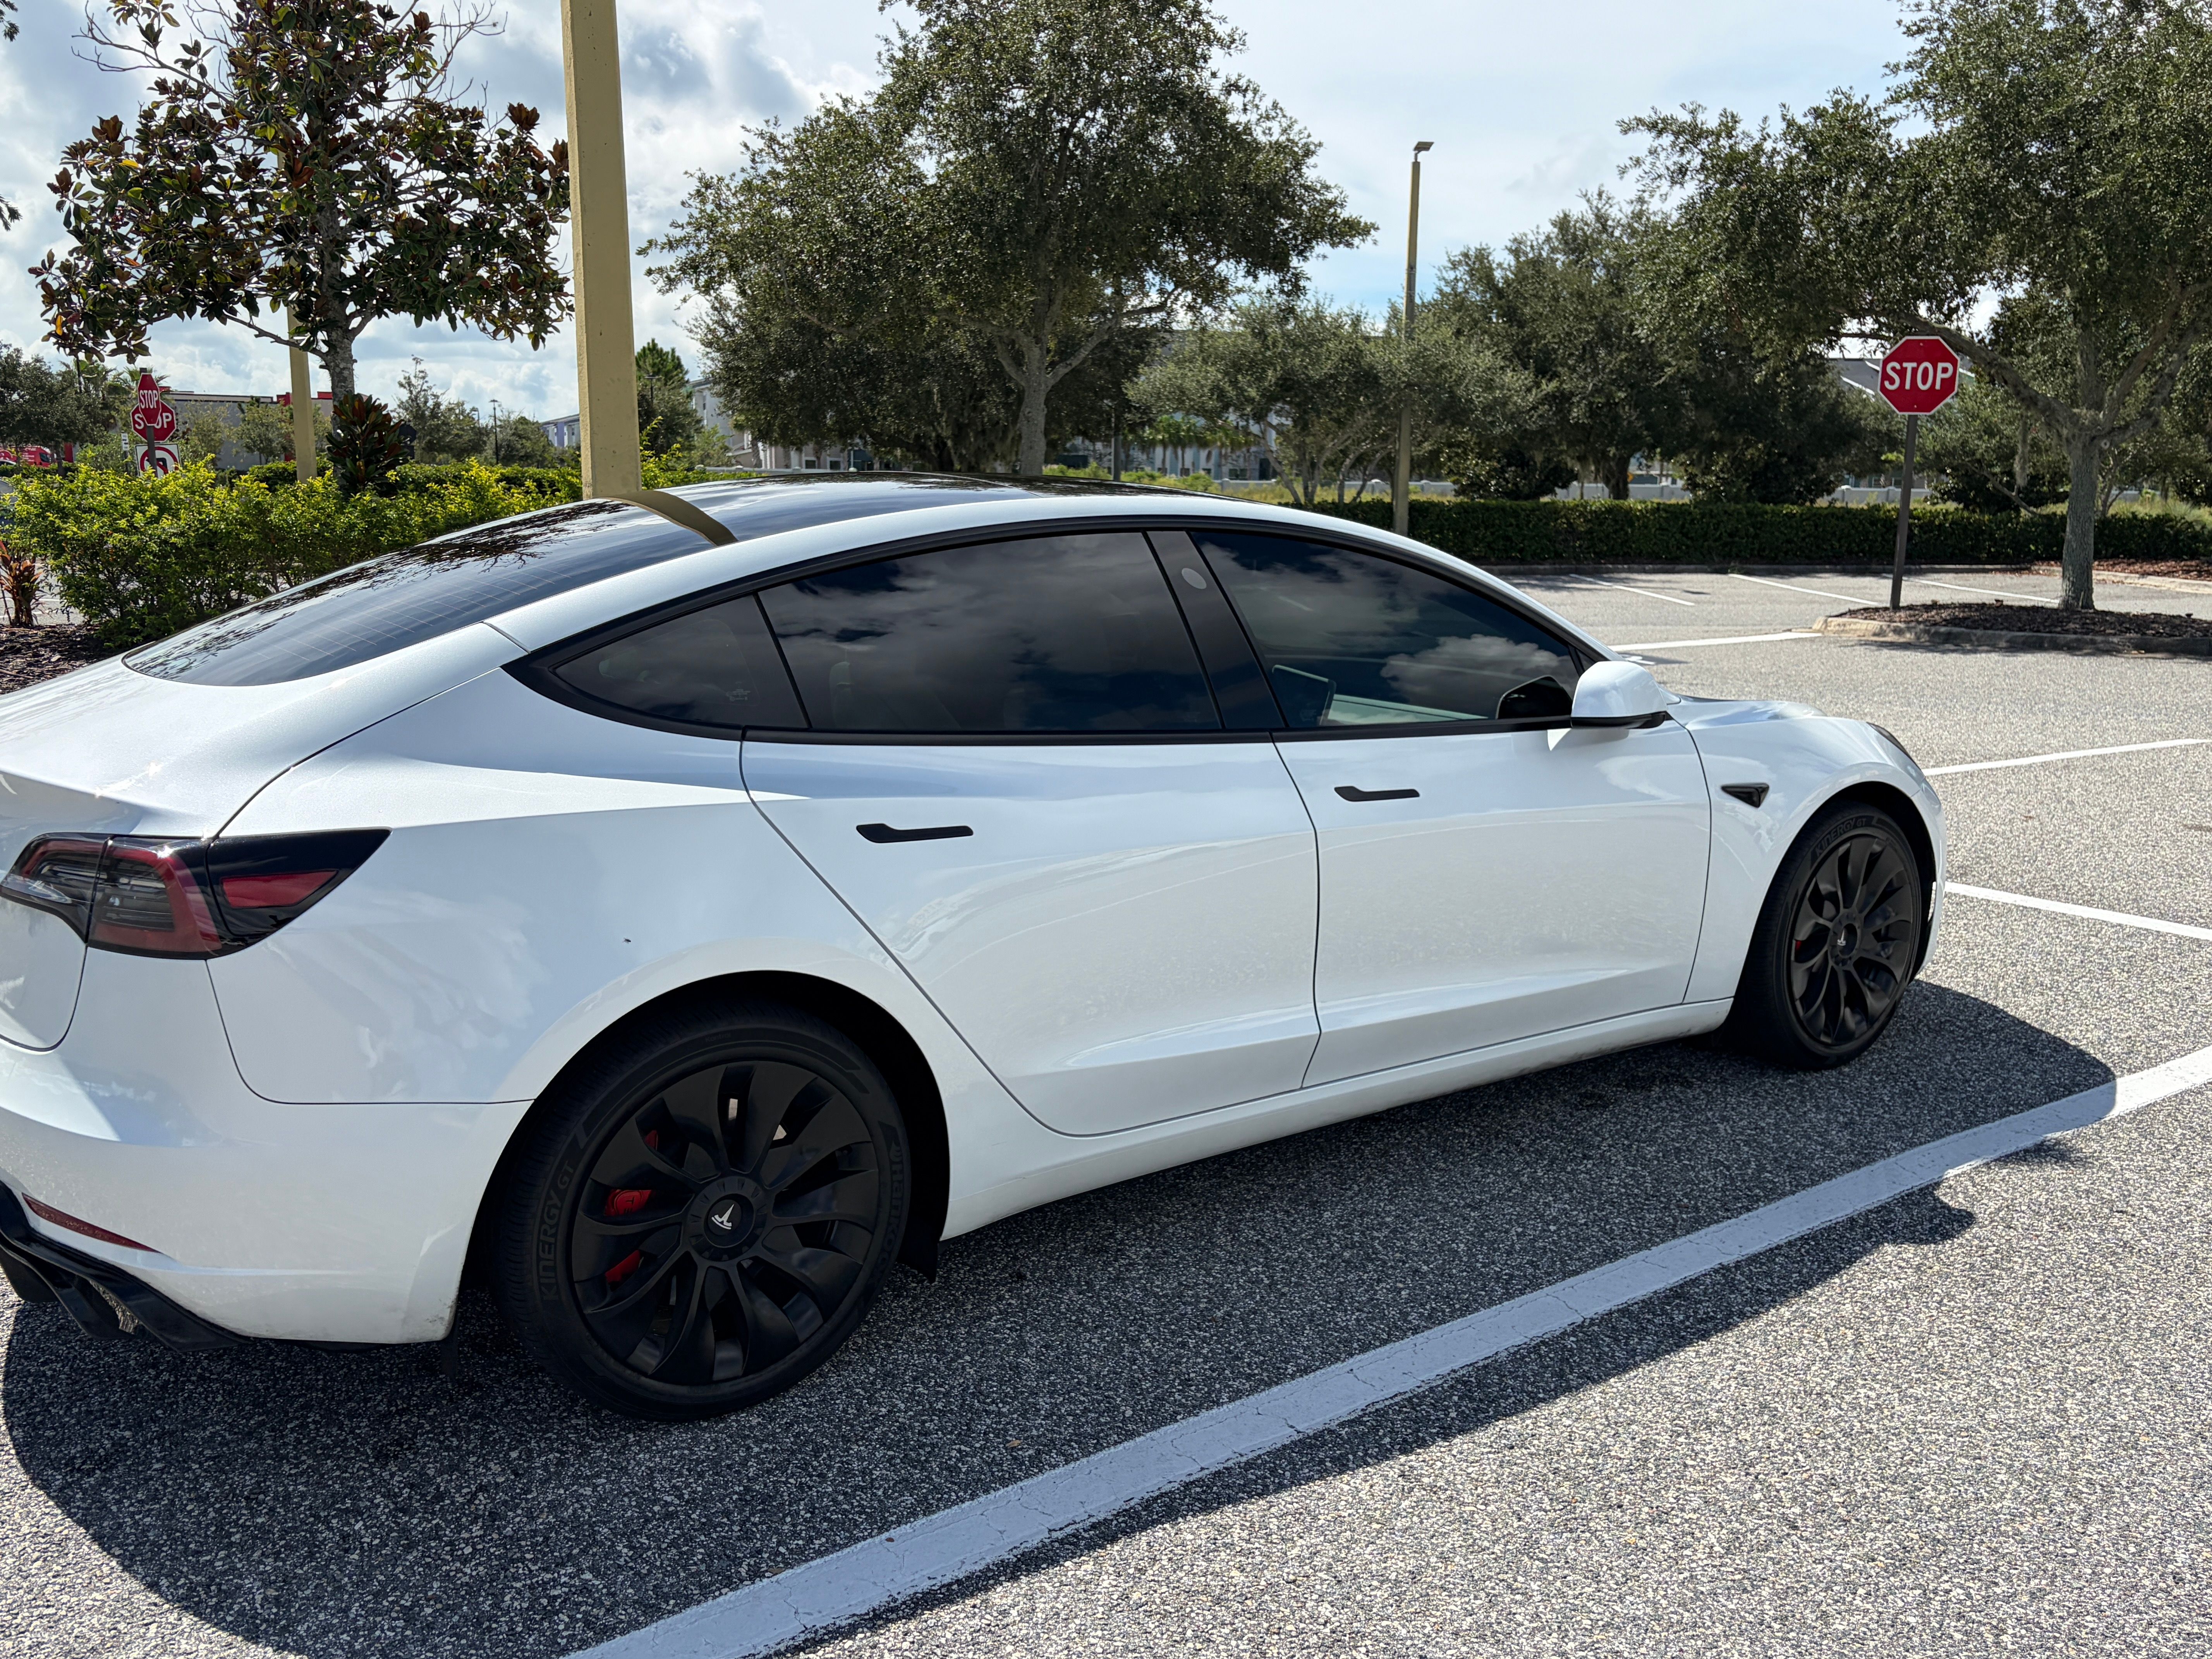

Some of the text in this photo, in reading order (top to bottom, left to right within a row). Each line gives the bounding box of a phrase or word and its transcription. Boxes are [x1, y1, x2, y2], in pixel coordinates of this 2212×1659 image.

[1884, 361, 1953, 390] STOP
[139, 390, 158, 409] STOP
[134, 412, 172, 429] SOP
[1857, 819, 1866, 827] GT
[558, 1160, 574, 1189] GT
